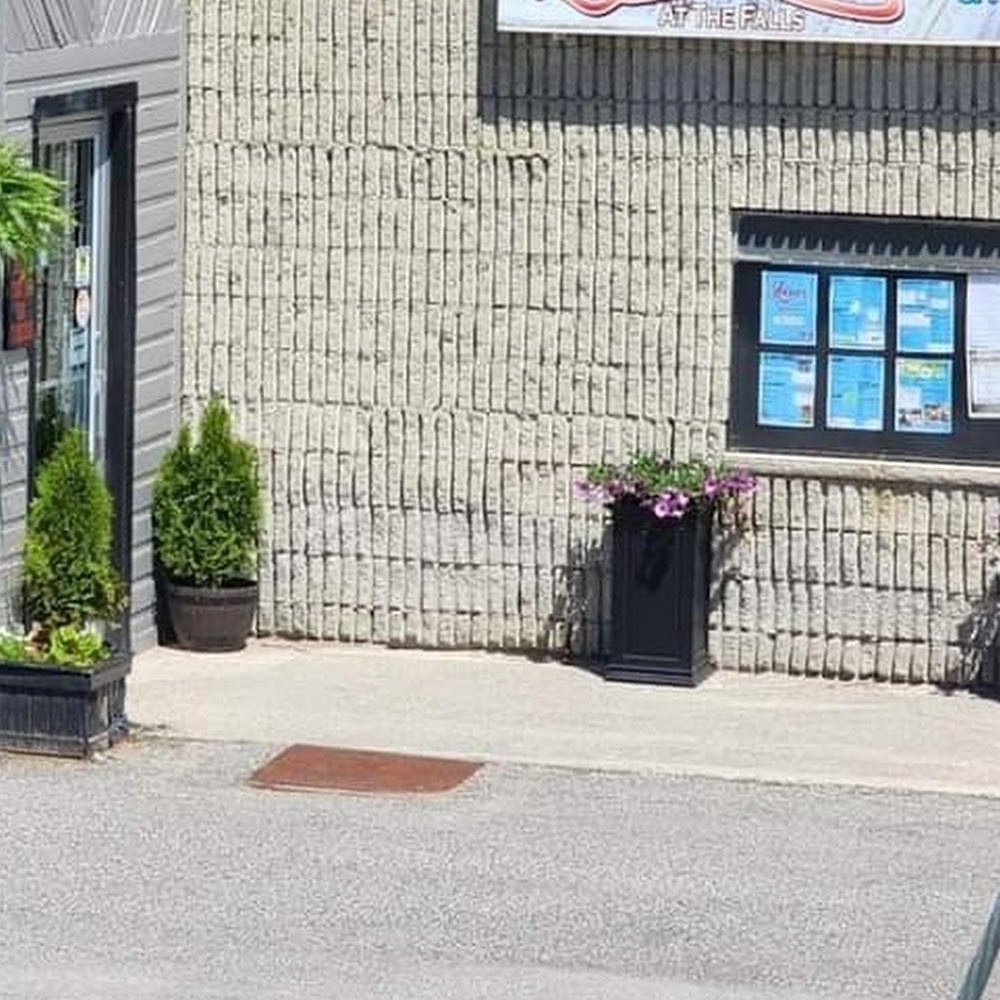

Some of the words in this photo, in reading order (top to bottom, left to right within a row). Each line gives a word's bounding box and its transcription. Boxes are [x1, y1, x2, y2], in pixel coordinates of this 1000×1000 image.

[656, 1, 690, 28] AT
[690, 1, 736, 30] THE
[738, 2, 806, 32] FALLS
